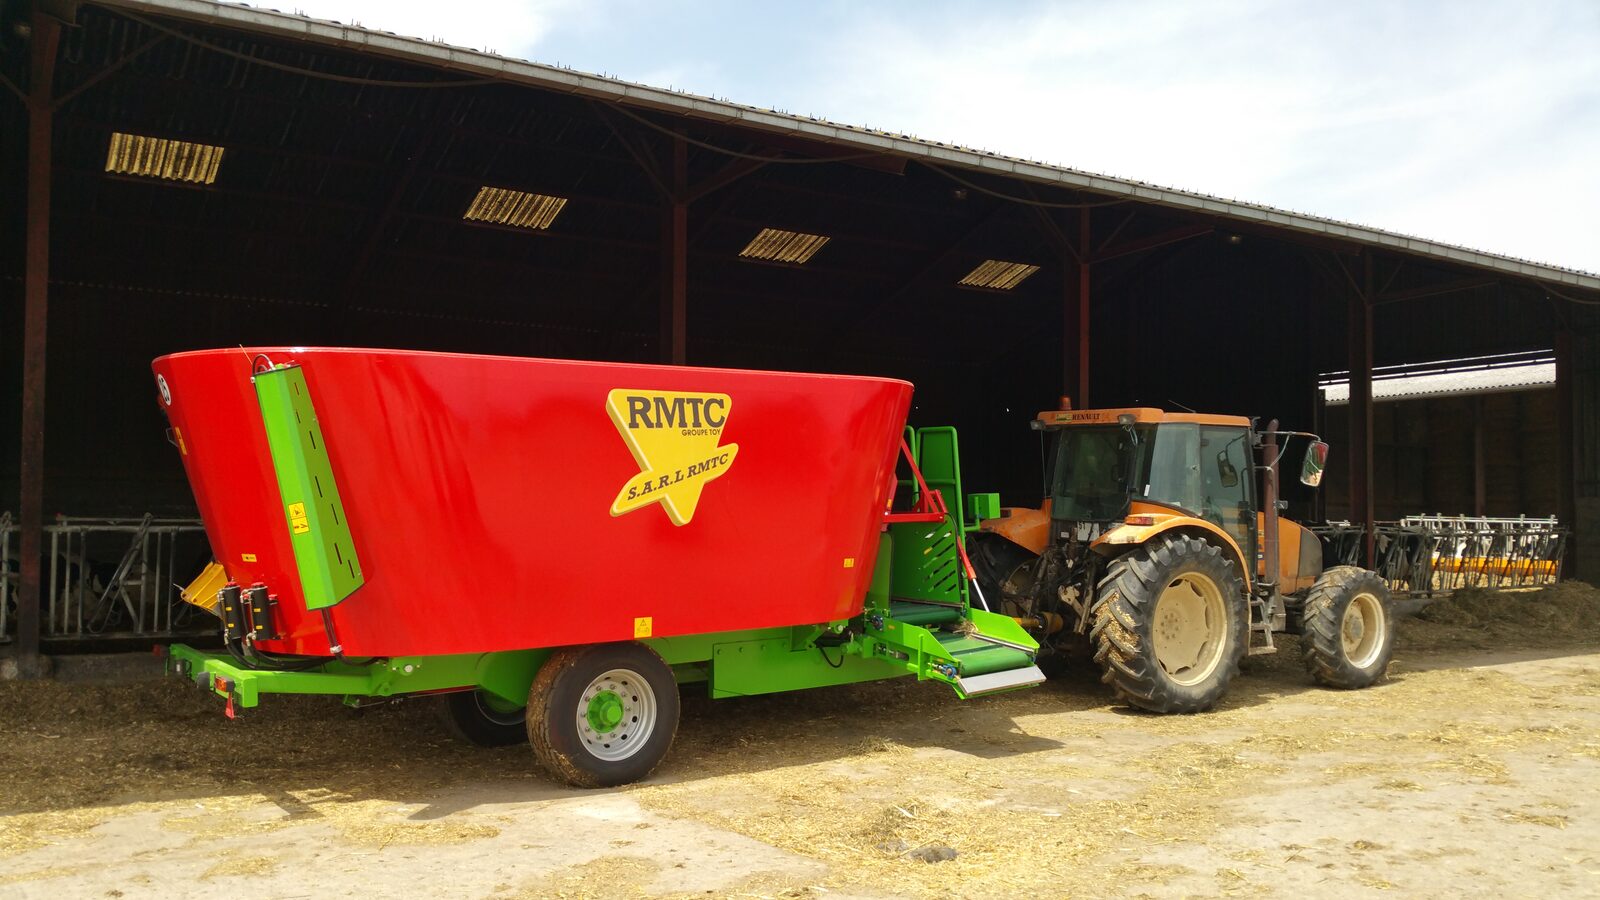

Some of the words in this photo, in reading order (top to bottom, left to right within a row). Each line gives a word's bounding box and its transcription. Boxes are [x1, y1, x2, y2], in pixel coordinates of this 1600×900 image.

[627, 396, 725, 428] RMTC
[709, 428, 720, 436] TOY
[627, 470, 684, 501] S.A.R.L
[687, 453, 728, 478] RMTC
